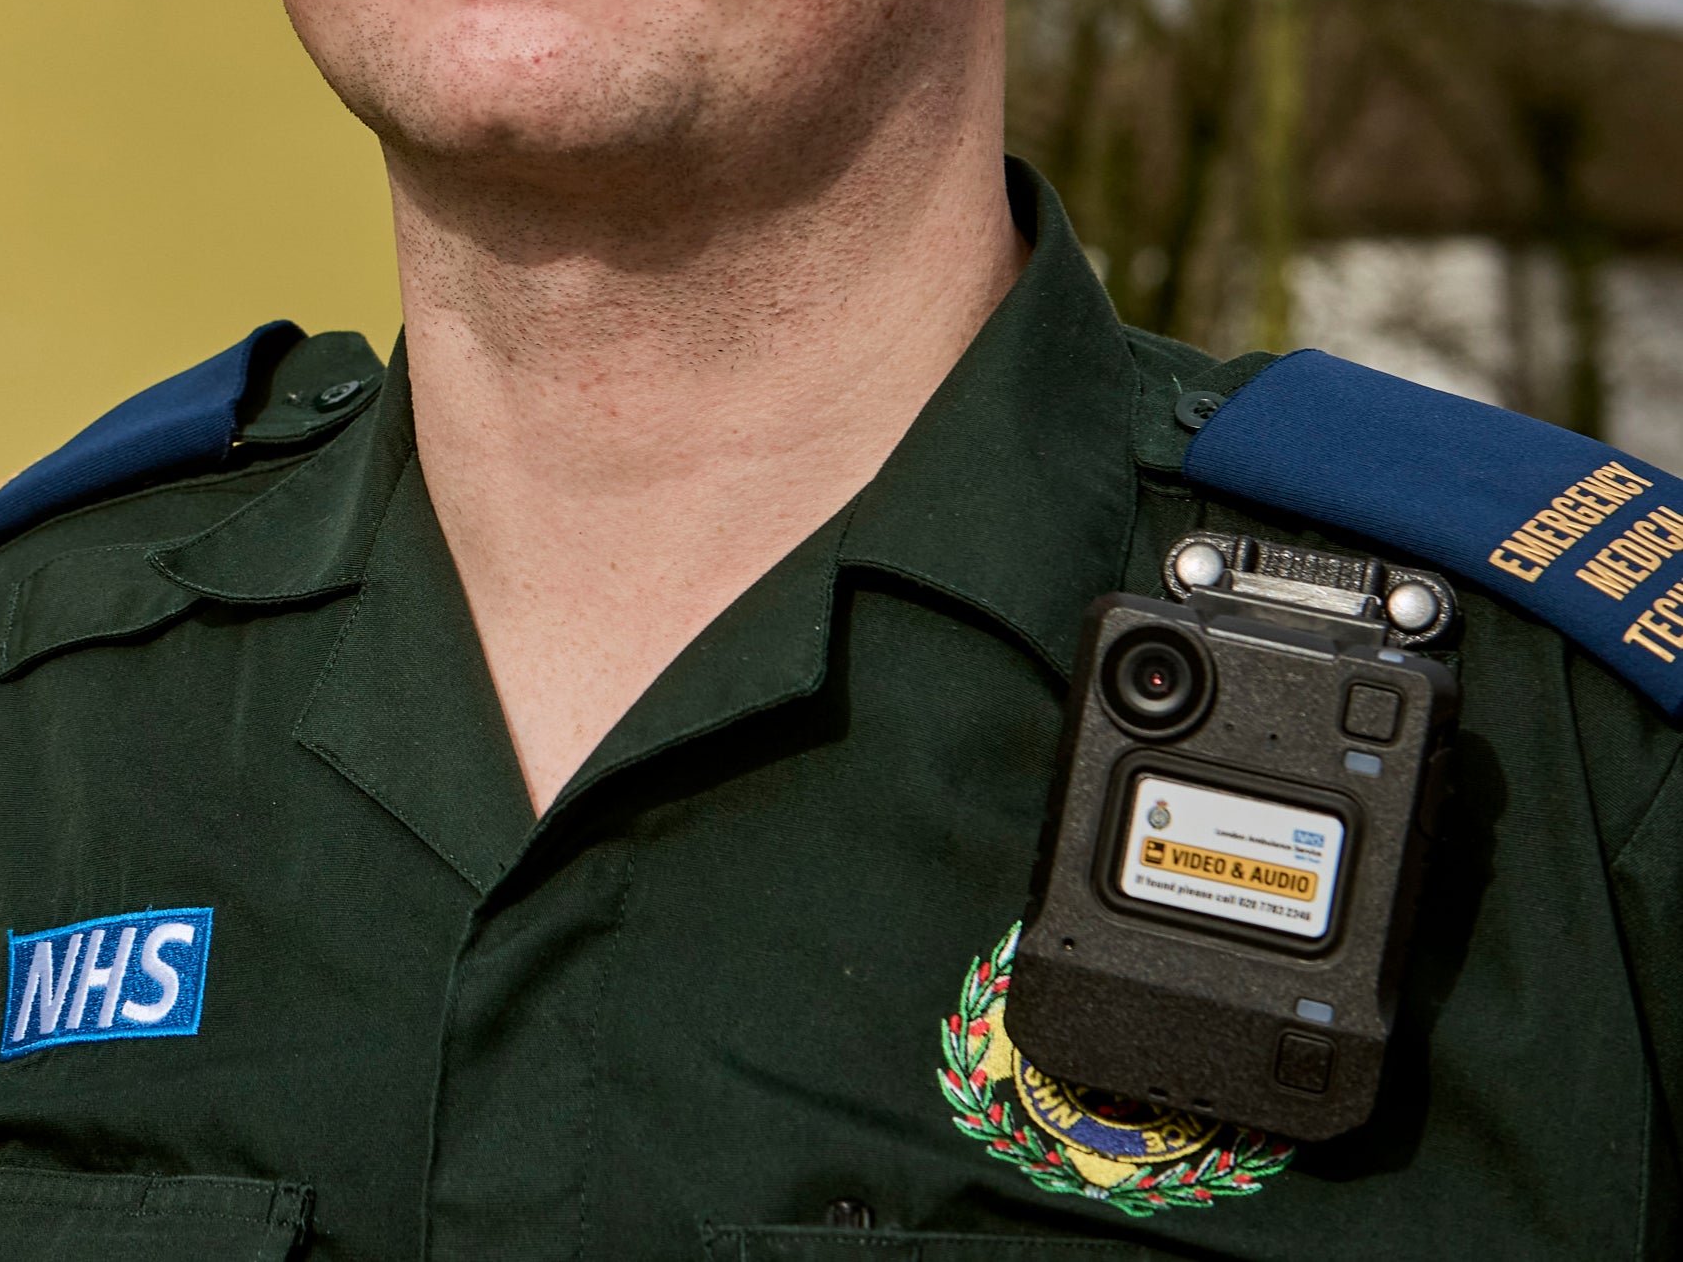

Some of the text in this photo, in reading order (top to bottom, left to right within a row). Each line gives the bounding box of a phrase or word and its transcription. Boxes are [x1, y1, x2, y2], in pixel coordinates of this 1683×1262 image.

[1487, 460, 1654, 583] EMERGENCY
[1146, 876, 1176, 892] found
[1178, 882, 1213, 900] please
[1216, 889, 1236, 905] call
[1171, 848, 1310, 894] VIDEO & AUDIO
[12, 922, 195, 1042] NHS
